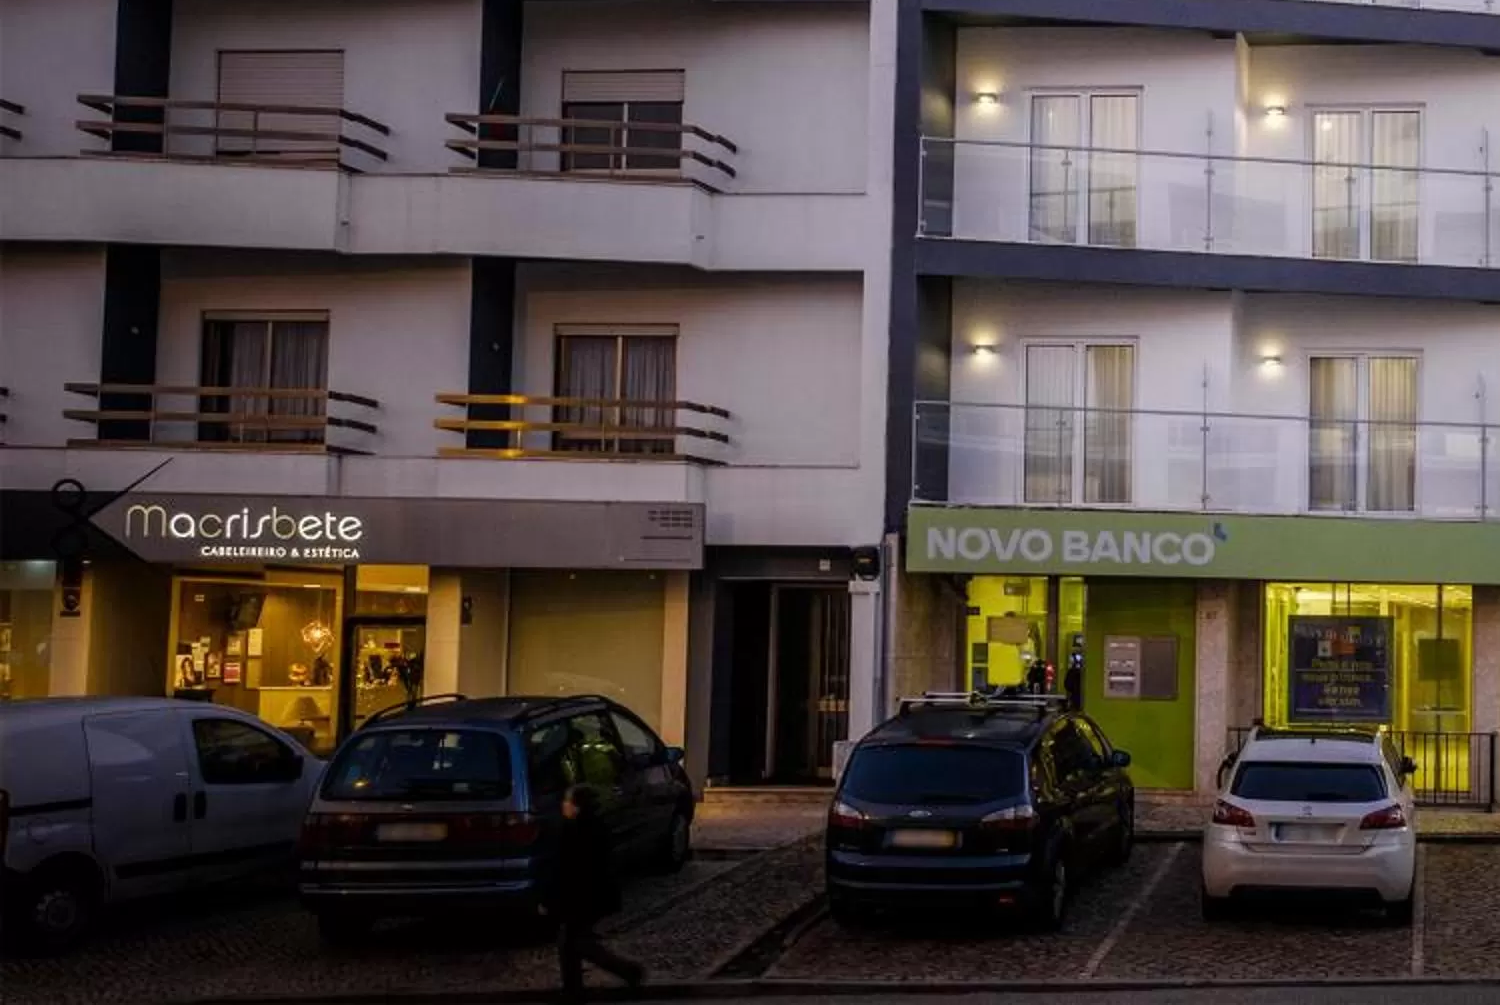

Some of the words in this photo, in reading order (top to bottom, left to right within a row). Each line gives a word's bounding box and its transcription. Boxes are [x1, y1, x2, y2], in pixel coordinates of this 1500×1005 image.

[291, 547, 301, 558] &
[303, 544, 360, 559] ESTÉTICA
[927, 527, 1053, 562] NOVO
[1062, 530, 1215, 565] BANCO
